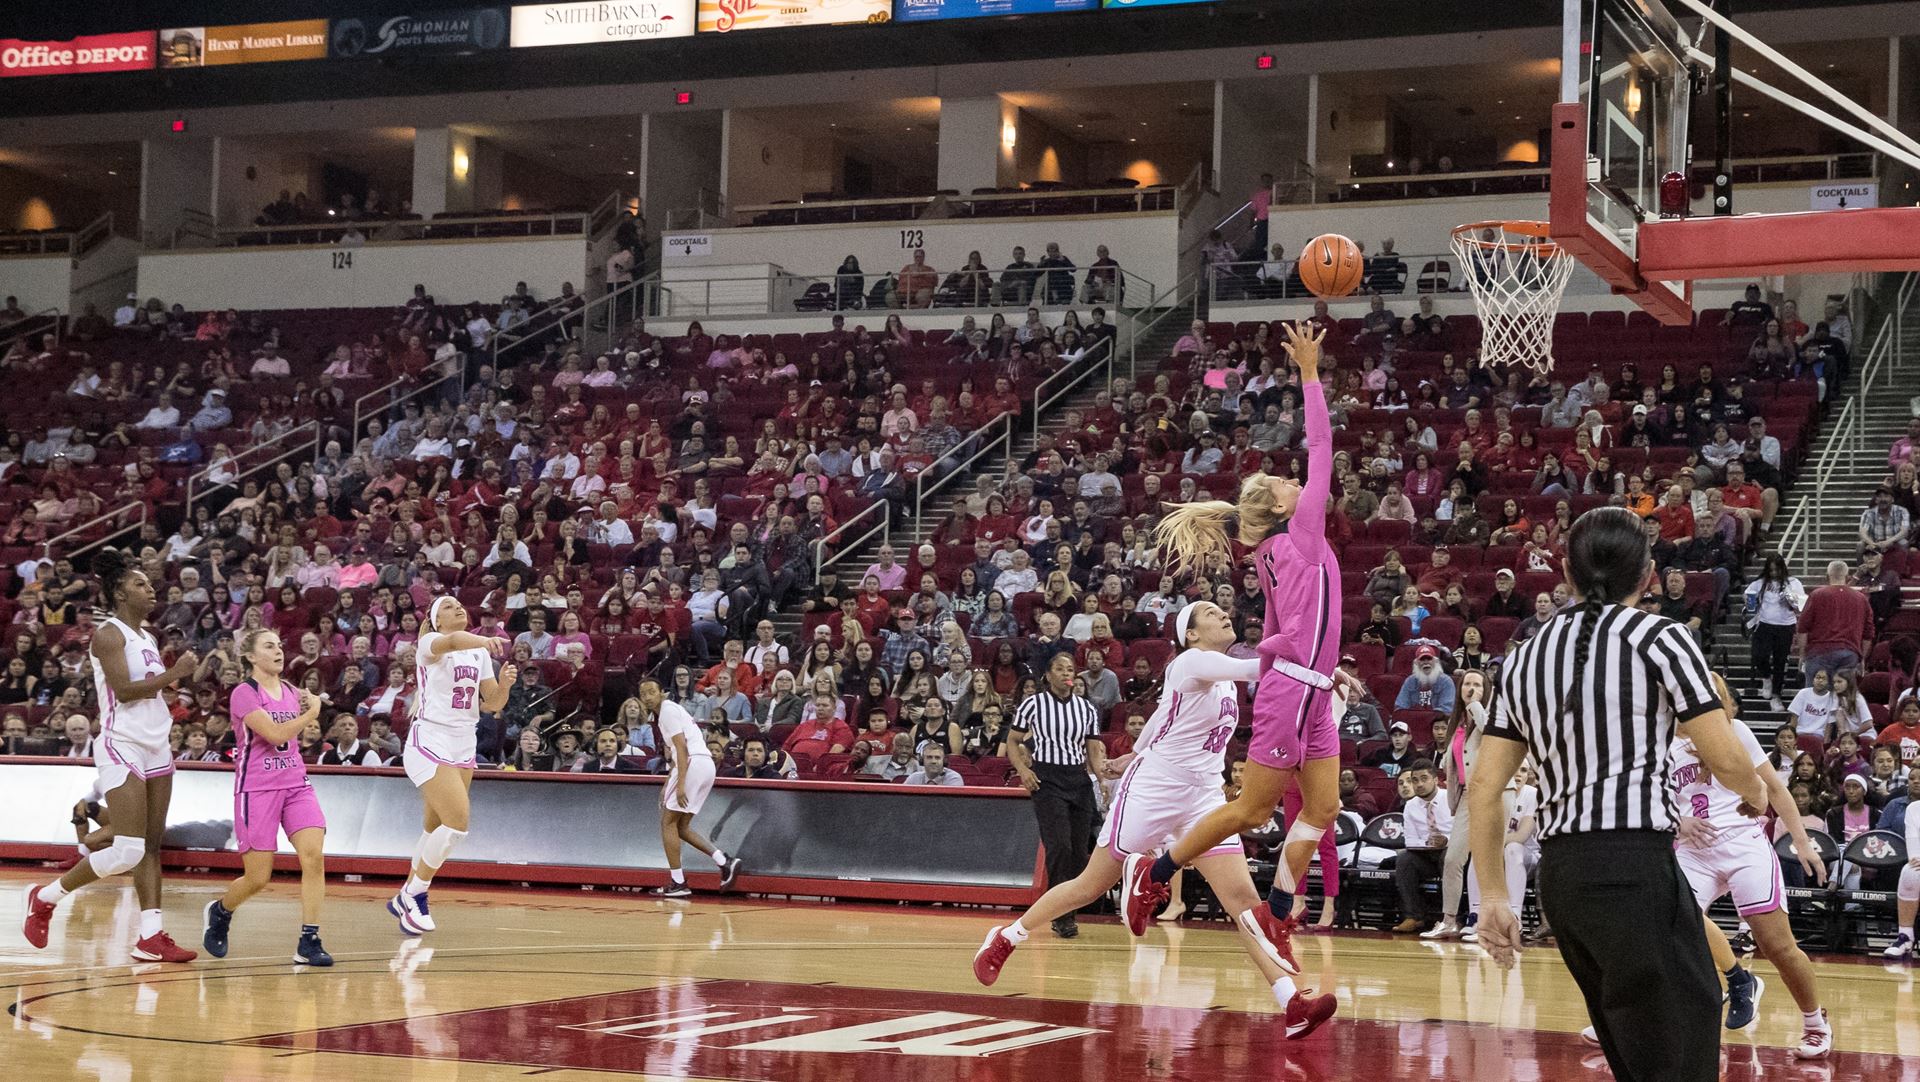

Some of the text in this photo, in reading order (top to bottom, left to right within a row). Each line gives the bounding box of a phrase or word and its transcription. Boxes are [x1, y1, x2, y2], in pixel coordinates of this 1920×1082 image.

[544, 3, 659, 26] SMITH BARNEY
[398, 19, 469, 35] SIMONIAN
[606, 23, 663, 38] citigroup
[207, 34, 325, 52] HENRY MADDEN LIBRARY
[423, 33, 469, 45] Medicine
[1, 45, 148, 69] Office DEPOT
[1816, 187, 1869, 198] COCKTAILS
[669, 237, 708, 246] COCKTAILS
[900, 230, 924, 249] 123
[332, 251, 353, 269] 124
[1690, 792, 1710, 820] 2
[1359, 870, 1391, 880] BULLDOGS
[1851, 891, 1887, 901] BULLDOGS
